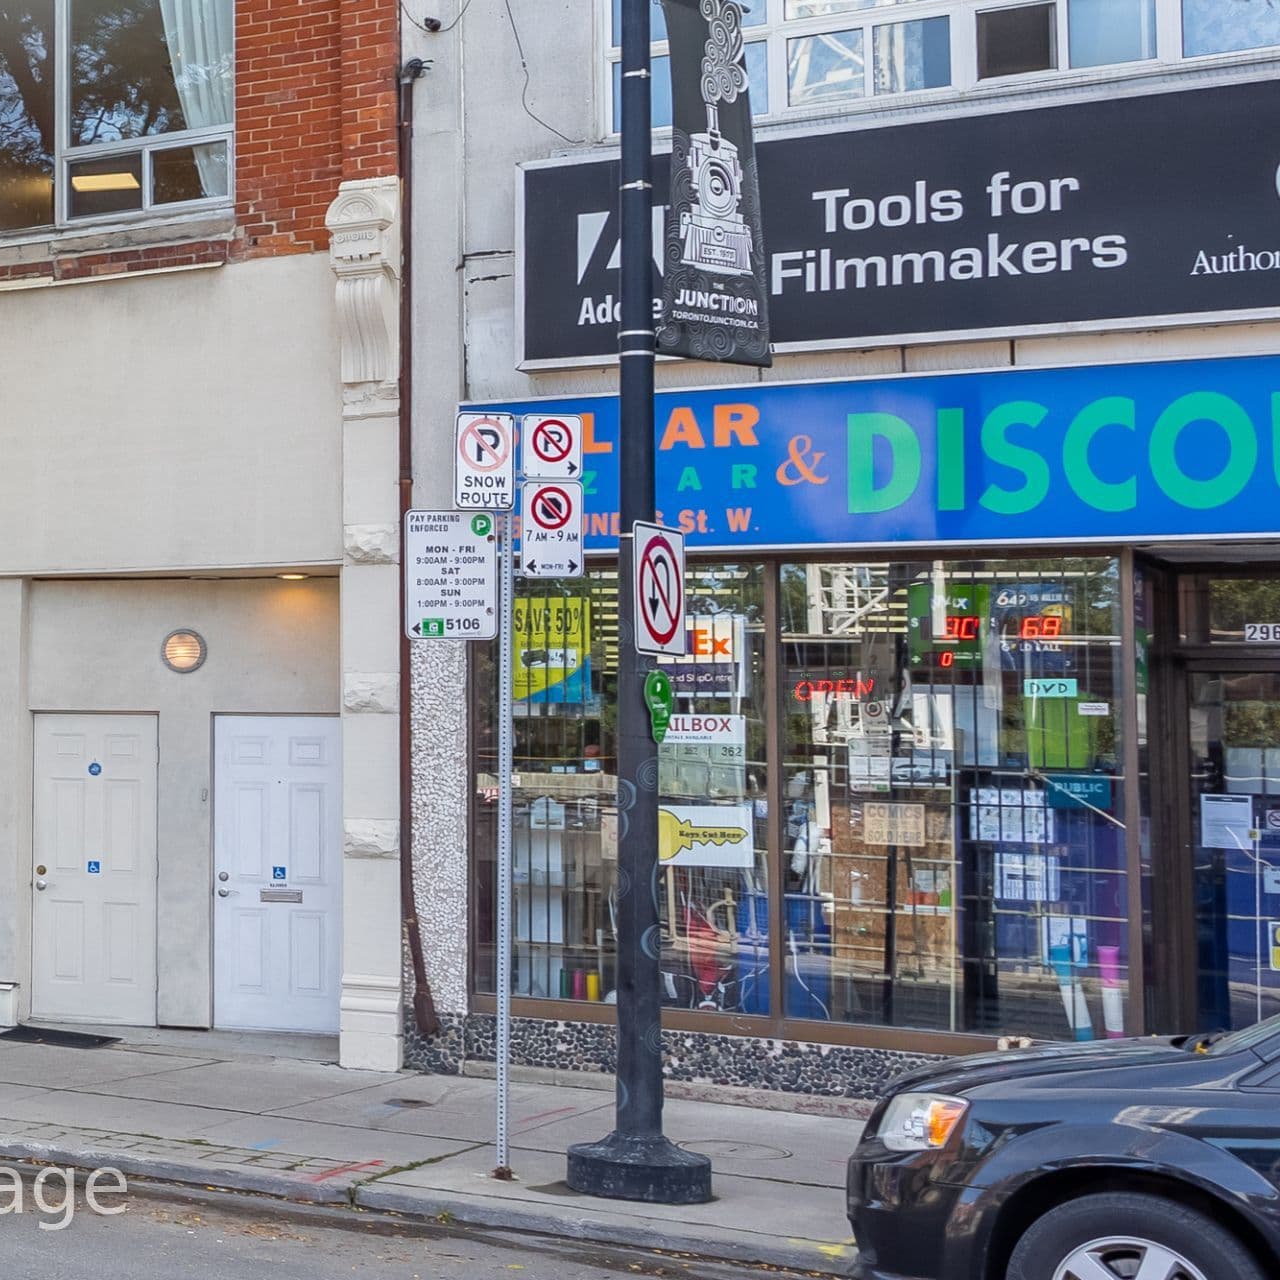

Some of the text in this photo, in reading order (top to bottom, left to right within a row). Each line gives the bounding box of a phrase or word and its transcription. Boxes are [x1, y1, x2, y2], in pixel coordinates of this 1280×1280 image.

[811, 171, 1080, 233] Tools for
[771, 232, 1128, 295] Filmmakers
[1190, 244, 1280, 277] Autho
[674, 288, 758, 316] JUNCTION
[671, 310, 759, 329] TORONTOJUNCTION.CA
[847, 391, 1280, 515] DISCO
[776, 435, 829, 486] &
[464, 476, 506, 488] SNOW
[460, 493, 509, 505] ROUTE
[410, 514, 460, 523] PAY PARKING
[678, 509, 715, 534] St.
[726, 507, 760, 533] W.
[410, 524, 449, 533] ENFORCED
[526, 530, 533, 542] 7
[535, 532, 548, 542] AM
[557, 530, 564, 542] 9
[566, 532, 579, 542] AM
[425, 546, 449, 554] MON
[458, 546, 476, 554] FRI
[415, 556, 449, 564] 9:00AM
[454, 556, 486, 564] 9:00PM
[440, 567, 461, 575] SAT
[416, 578, 449, 586] 8:00AM
[454, 578, 486, 586] 9:00PM
[440, 589, 461, 597] SUN
[417, 600, 449, 608] 1:00PM
[454, 600, 486, 608] 9:00PM
[446, 618, 480, 631] 5106
[515, 607, 584, 634] SAVE 50%
[794, 678, 874, 702] OPEN
[1029, 682, 1068, 695] DVD
[667, 717, 732, 732] AILBOX
[720, 746, 743, 757] 362
[1054, 782, 1105, 793] PUBLIC
[867, 805, 923, 819] COMICS
[702, 830, 718, 838] Cut
